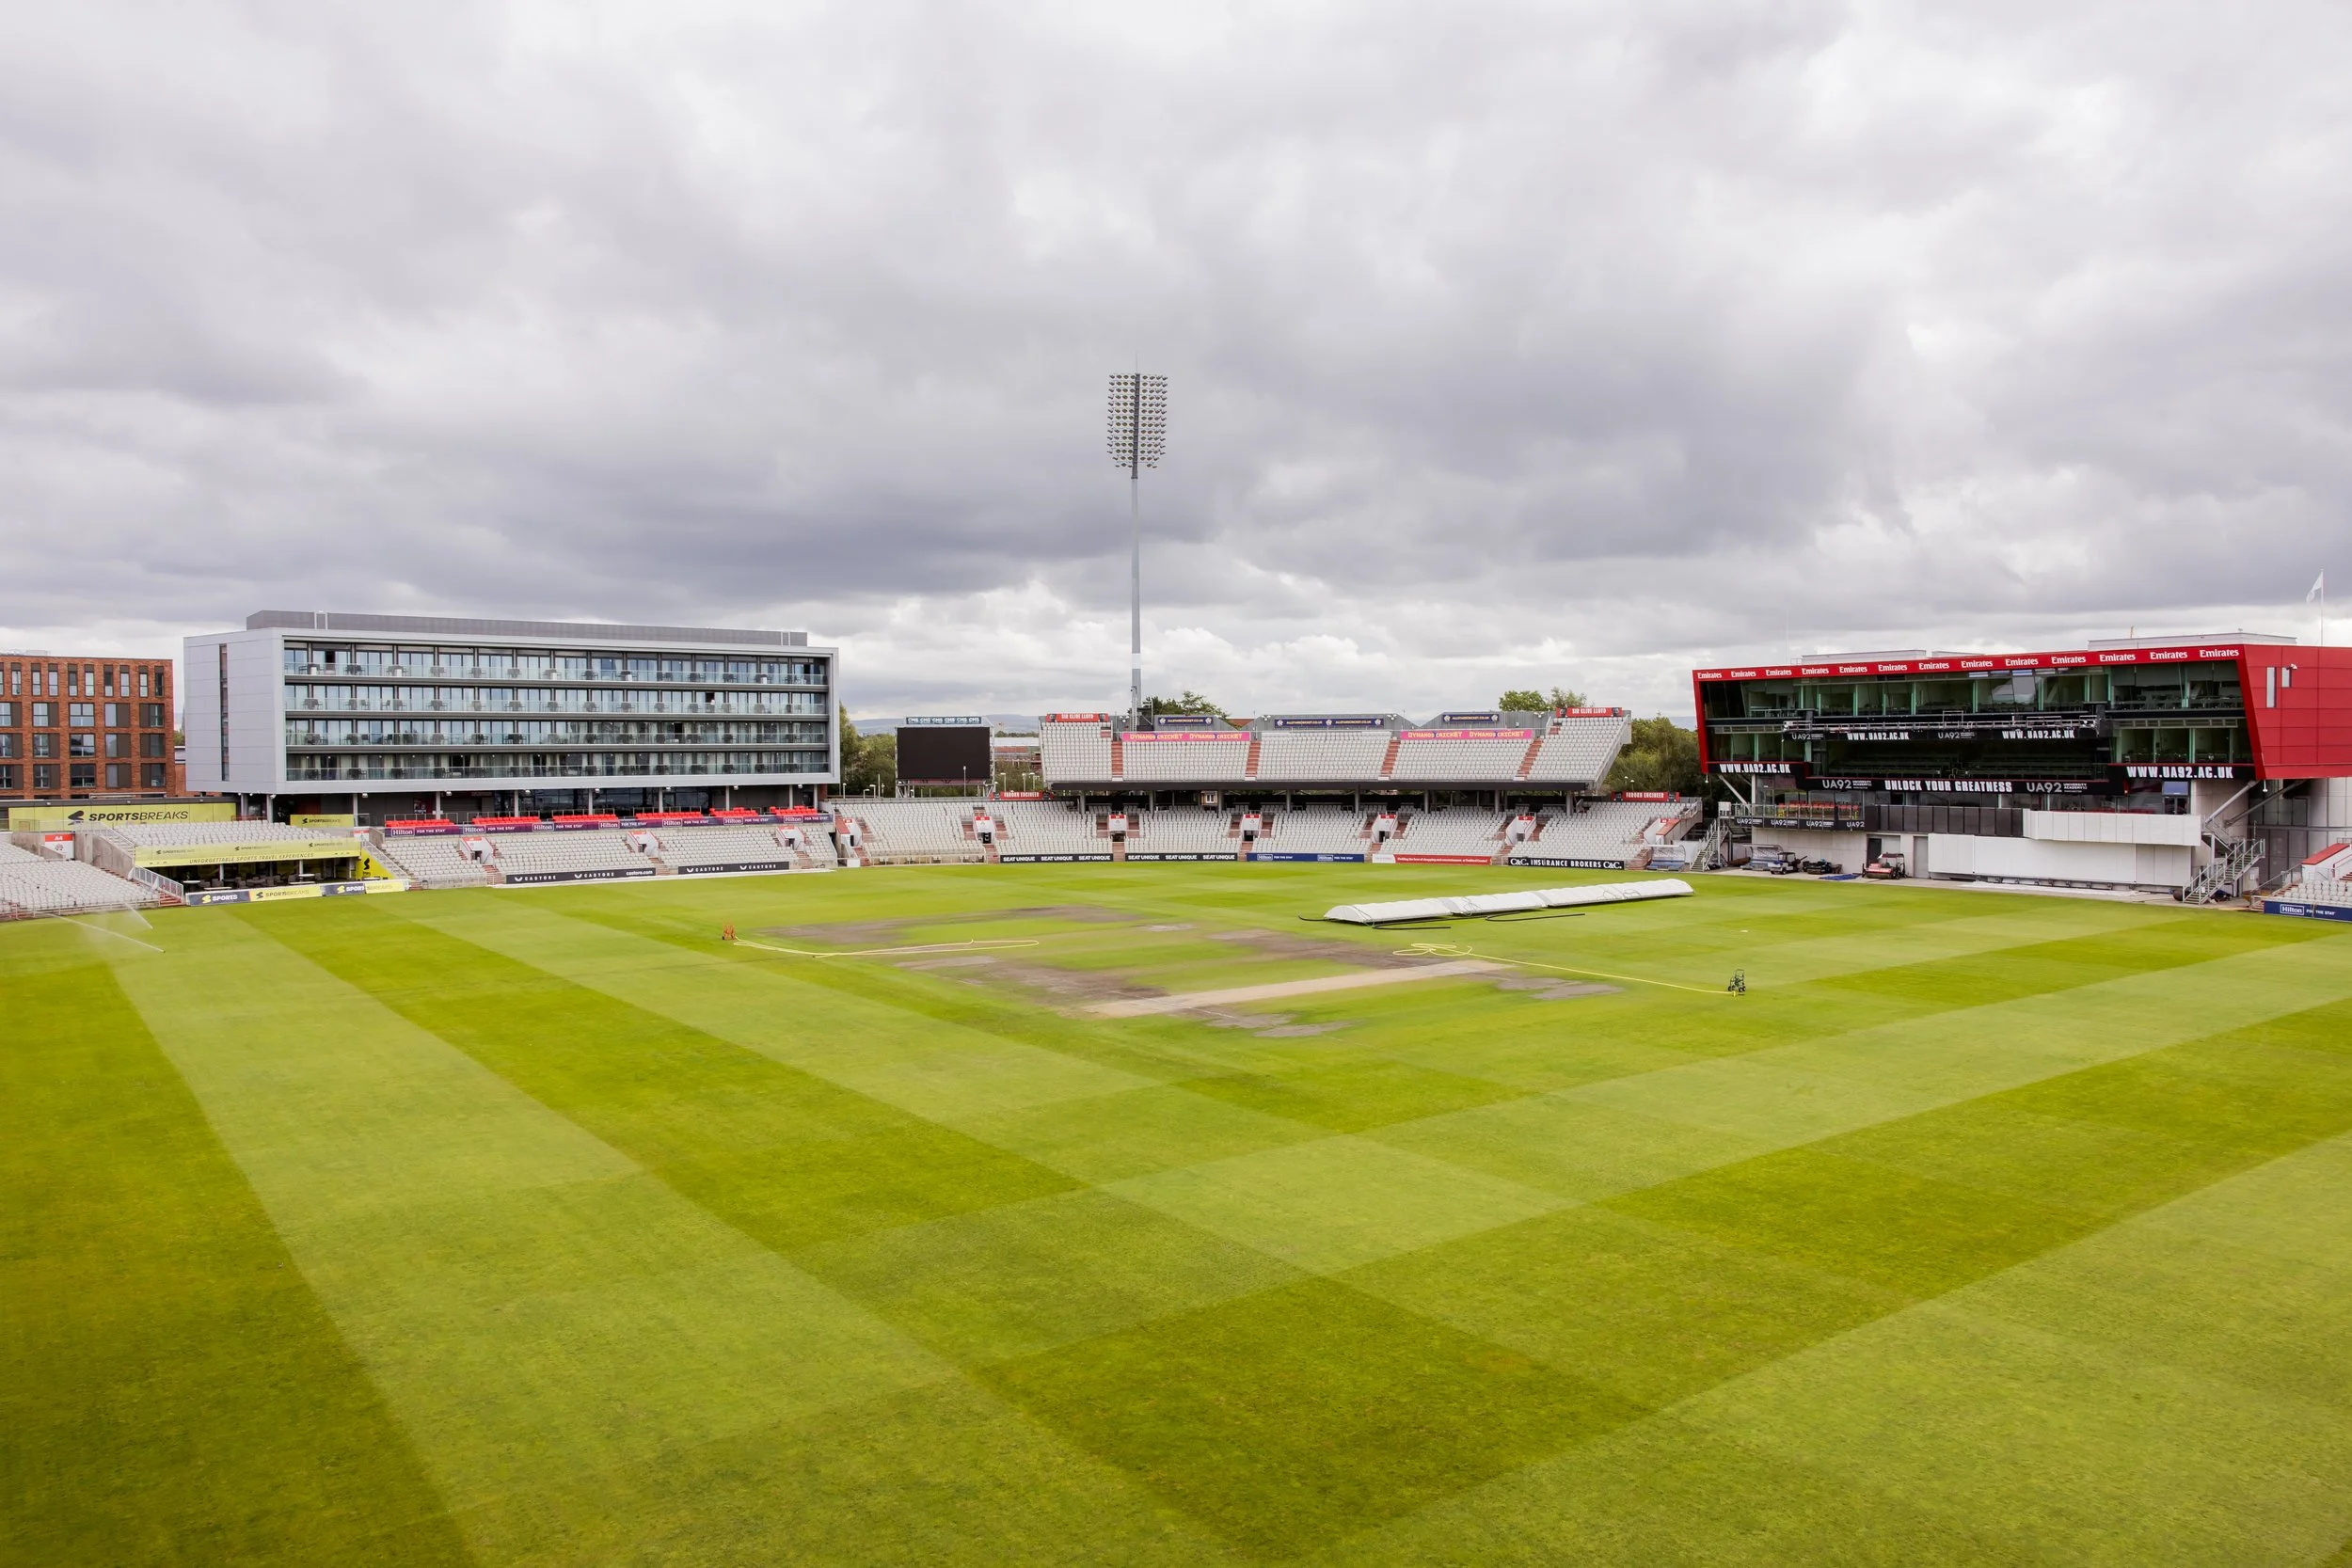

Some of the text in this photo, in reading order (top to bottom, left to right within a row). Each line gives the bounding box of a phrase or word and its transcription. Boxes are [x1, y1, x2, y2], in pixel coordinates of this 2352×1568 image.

[2150, 650, 2187, 659] Emirates
[2200, 648, 2239, 657] Emirates
[2005, 657, 2039, 666] Emirates
[2051, 656, 2087, 664] Emirates
[2099, 654, 2136, 662] Emirates
[1719, 764, 1790, 773] WWW.UA92.AC.UK
[2126, 766, 2233, 778] WWW.UA92.AC.UK
[1822, 780, 1851, 789] UA92
[1884, 780, 2012, 792] UNLOCK YOUR GREATNESS
[2026, 782, 2062, 793] UA92
[88, 811, 188, 821] SPORTSBREAKS
